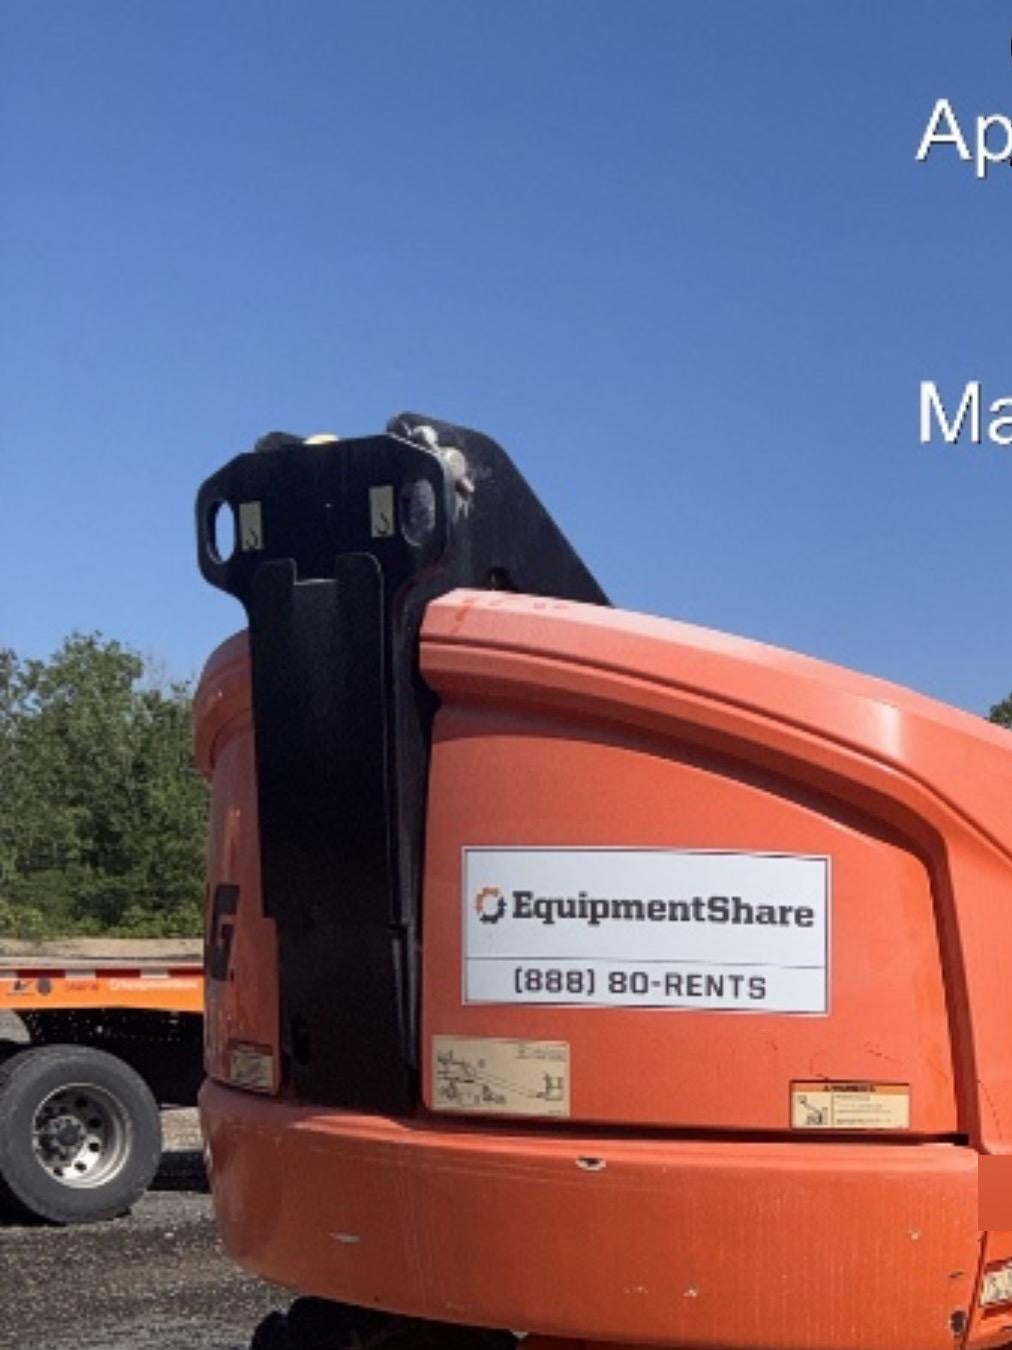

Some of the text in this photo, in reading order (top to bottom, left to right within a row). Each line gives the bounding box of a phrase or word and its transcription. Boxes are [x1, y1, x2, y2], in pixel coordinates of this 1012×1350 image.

[511, 890, 815, 927] EquipmentShare
[514, 967, 767, 1000] (888) 80-RENTS
